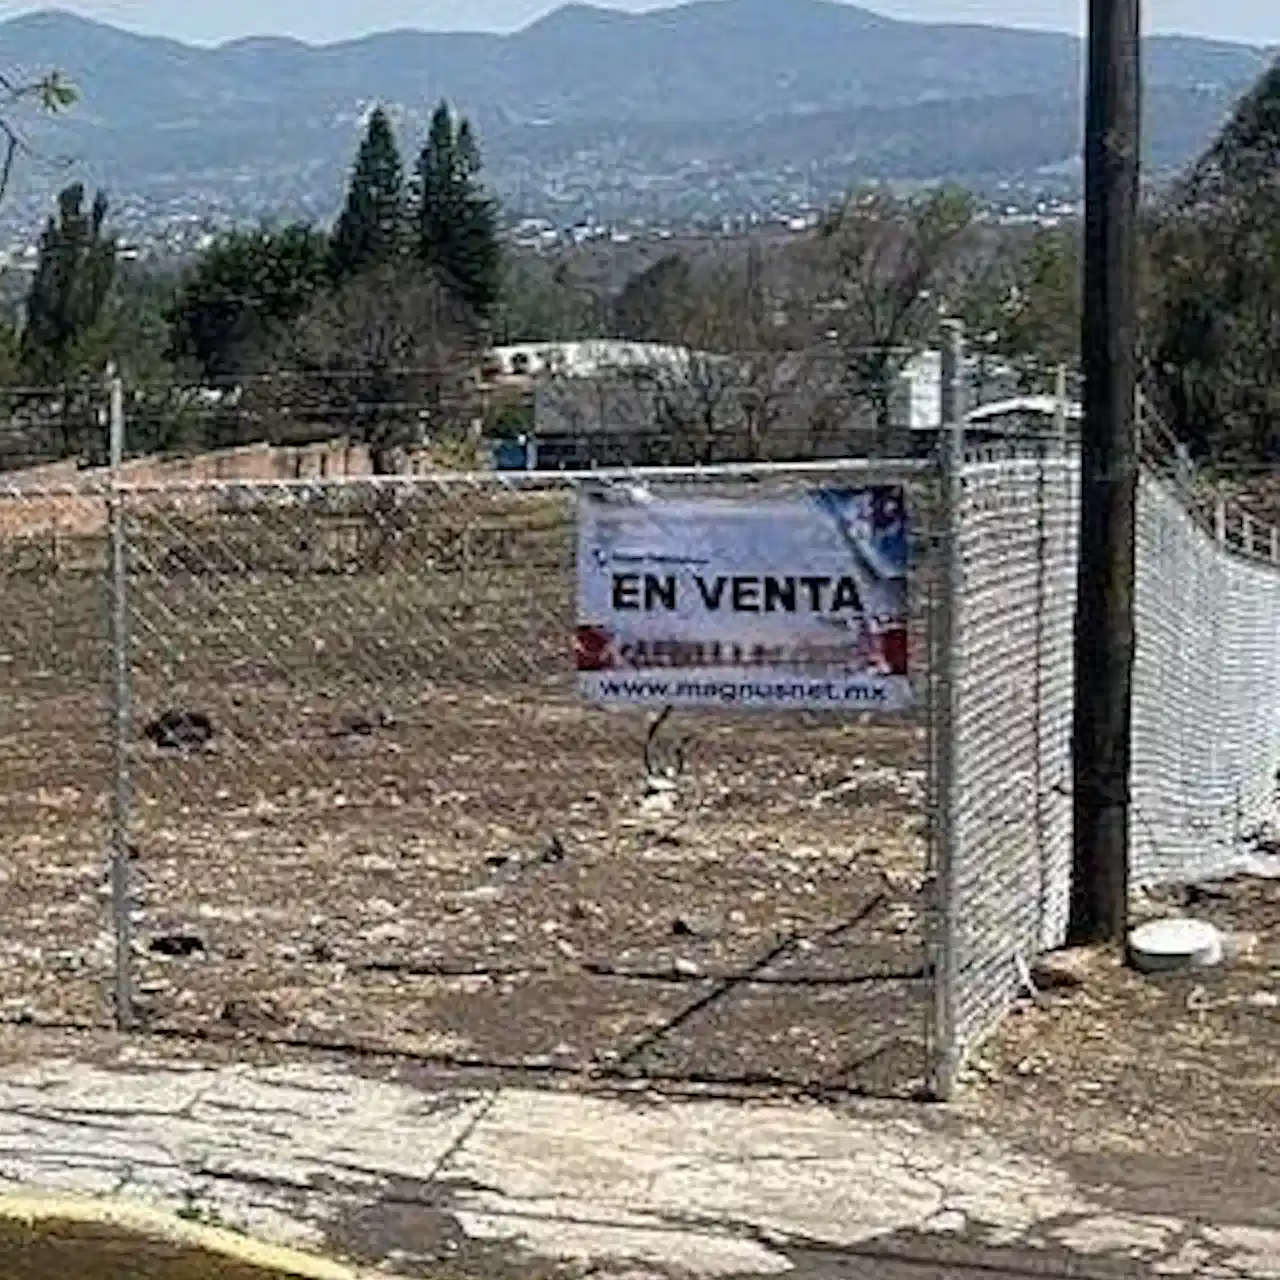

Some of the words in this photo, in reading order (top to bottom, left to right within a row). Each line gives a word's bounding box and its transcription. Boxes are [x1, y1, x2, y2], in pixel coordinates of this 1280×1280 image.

[611, 572, 677, 612] EN
[694, 575, 864, 613] VENTA
[599, 677, 888, 701] www.magnusnet.mx
